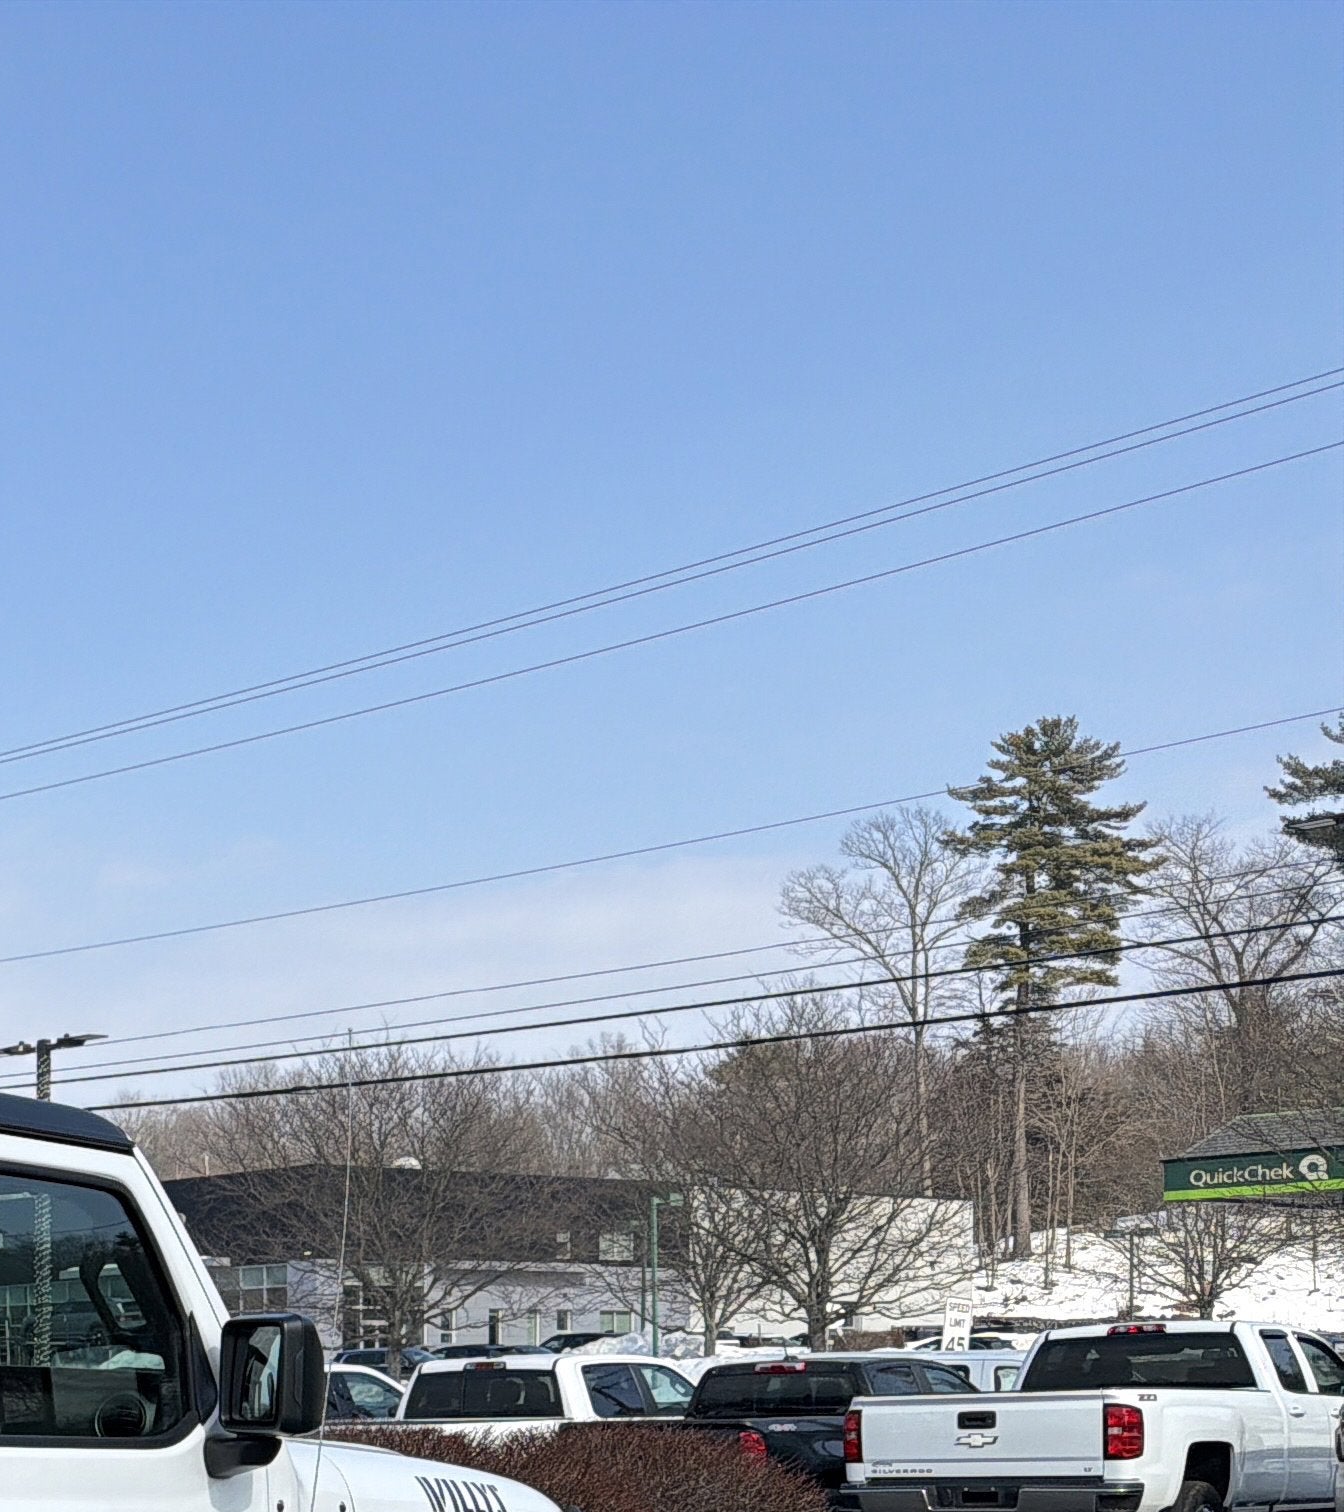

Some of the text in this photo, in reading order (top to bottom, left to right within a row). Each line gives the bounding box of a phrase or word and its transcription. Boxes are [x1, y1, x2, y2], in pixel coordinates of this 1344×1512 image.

[1189, 1162, 1295, 1188] QuickChek
[948, 1302, 971, 1313] SPEED
[944, 1336, 965, 1352] 45
